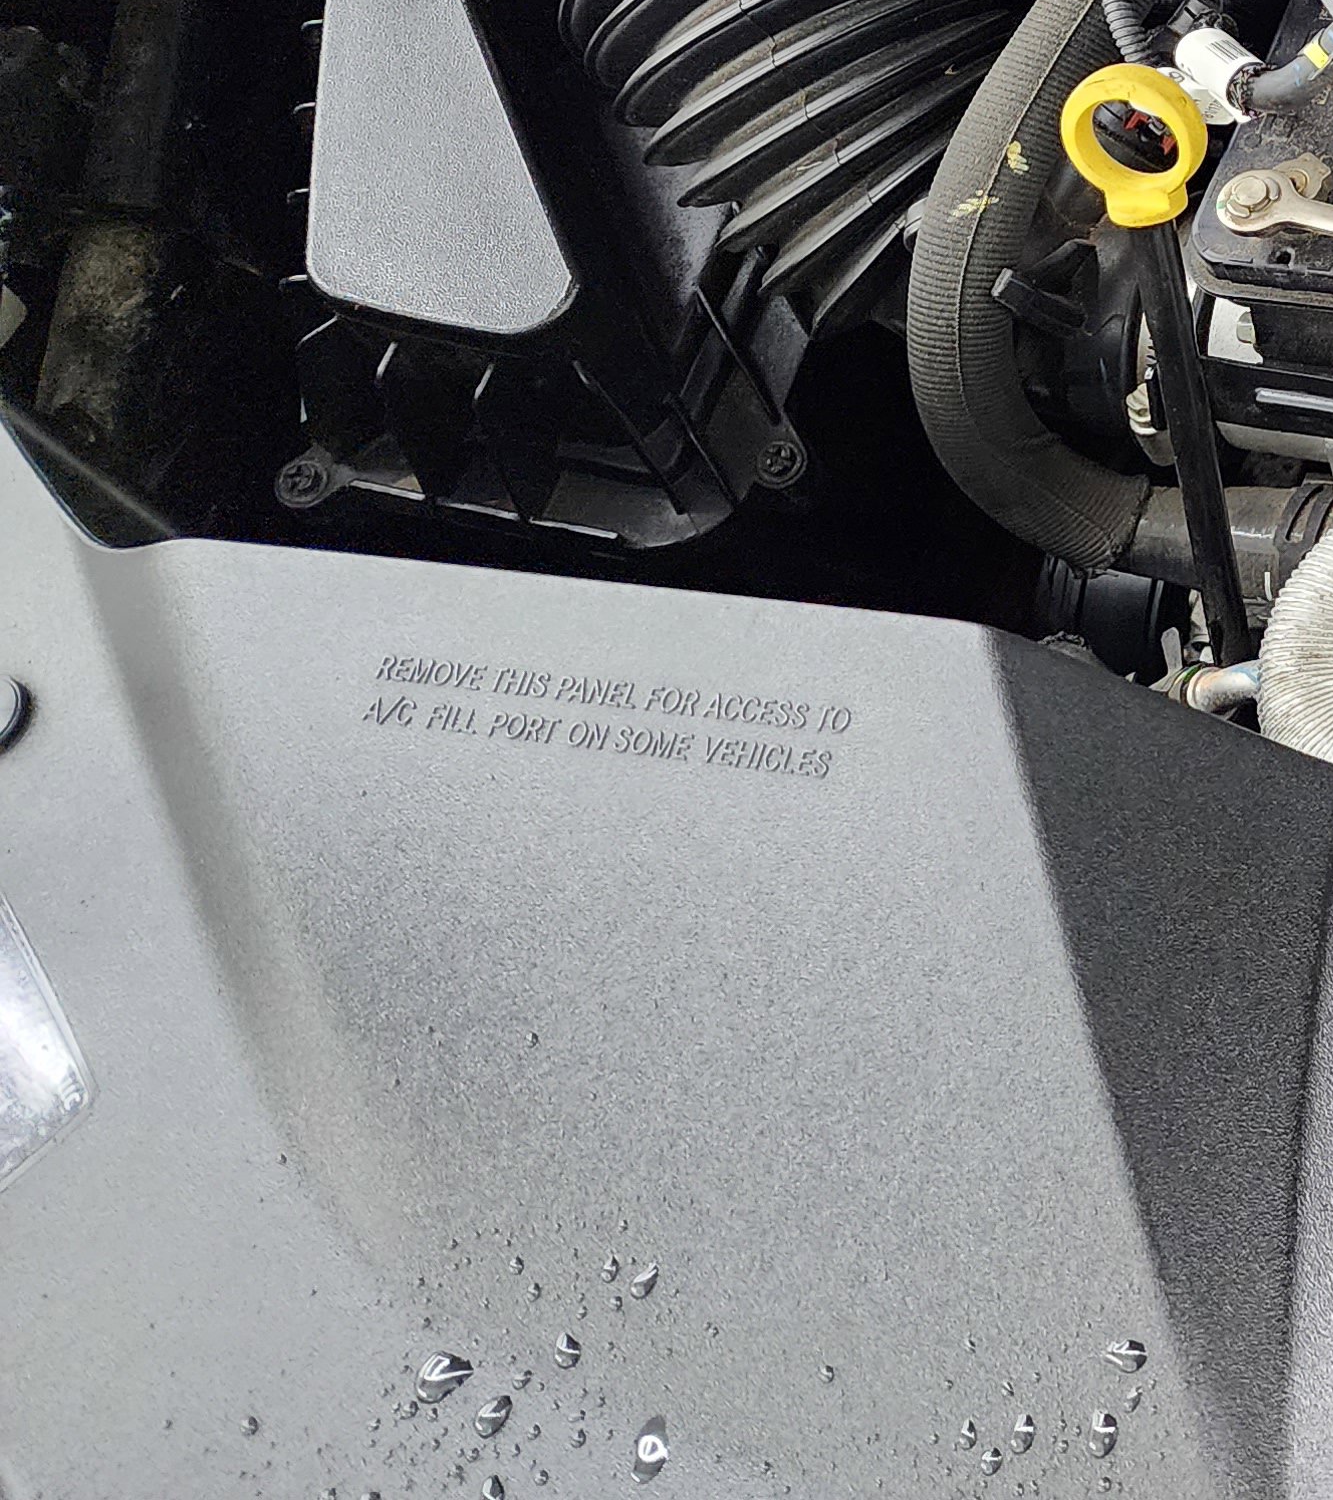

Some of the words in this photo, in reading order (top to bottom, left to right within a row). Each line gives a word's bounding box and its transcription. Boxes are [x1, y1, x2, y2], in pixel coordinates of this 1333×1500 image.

[375, 655, 488, 692] REMOVE
[491, 665, 551, 699] THIS
[554, 675, 637, 711] PANEL
[645, 686, 702, 718] FOR
[703, 692, 811, 730] ACCESS
[819, 706, 852, 734] TO
[363, 695, 415, 729] A/C
[426, 704, 478, 736] FILL
[487, 711, 561, 745] PORT
[567, 719, 610, 751] ON
[613, 726, 695, 761] SOME
[703, 736, 834, 780] VEHICLES
